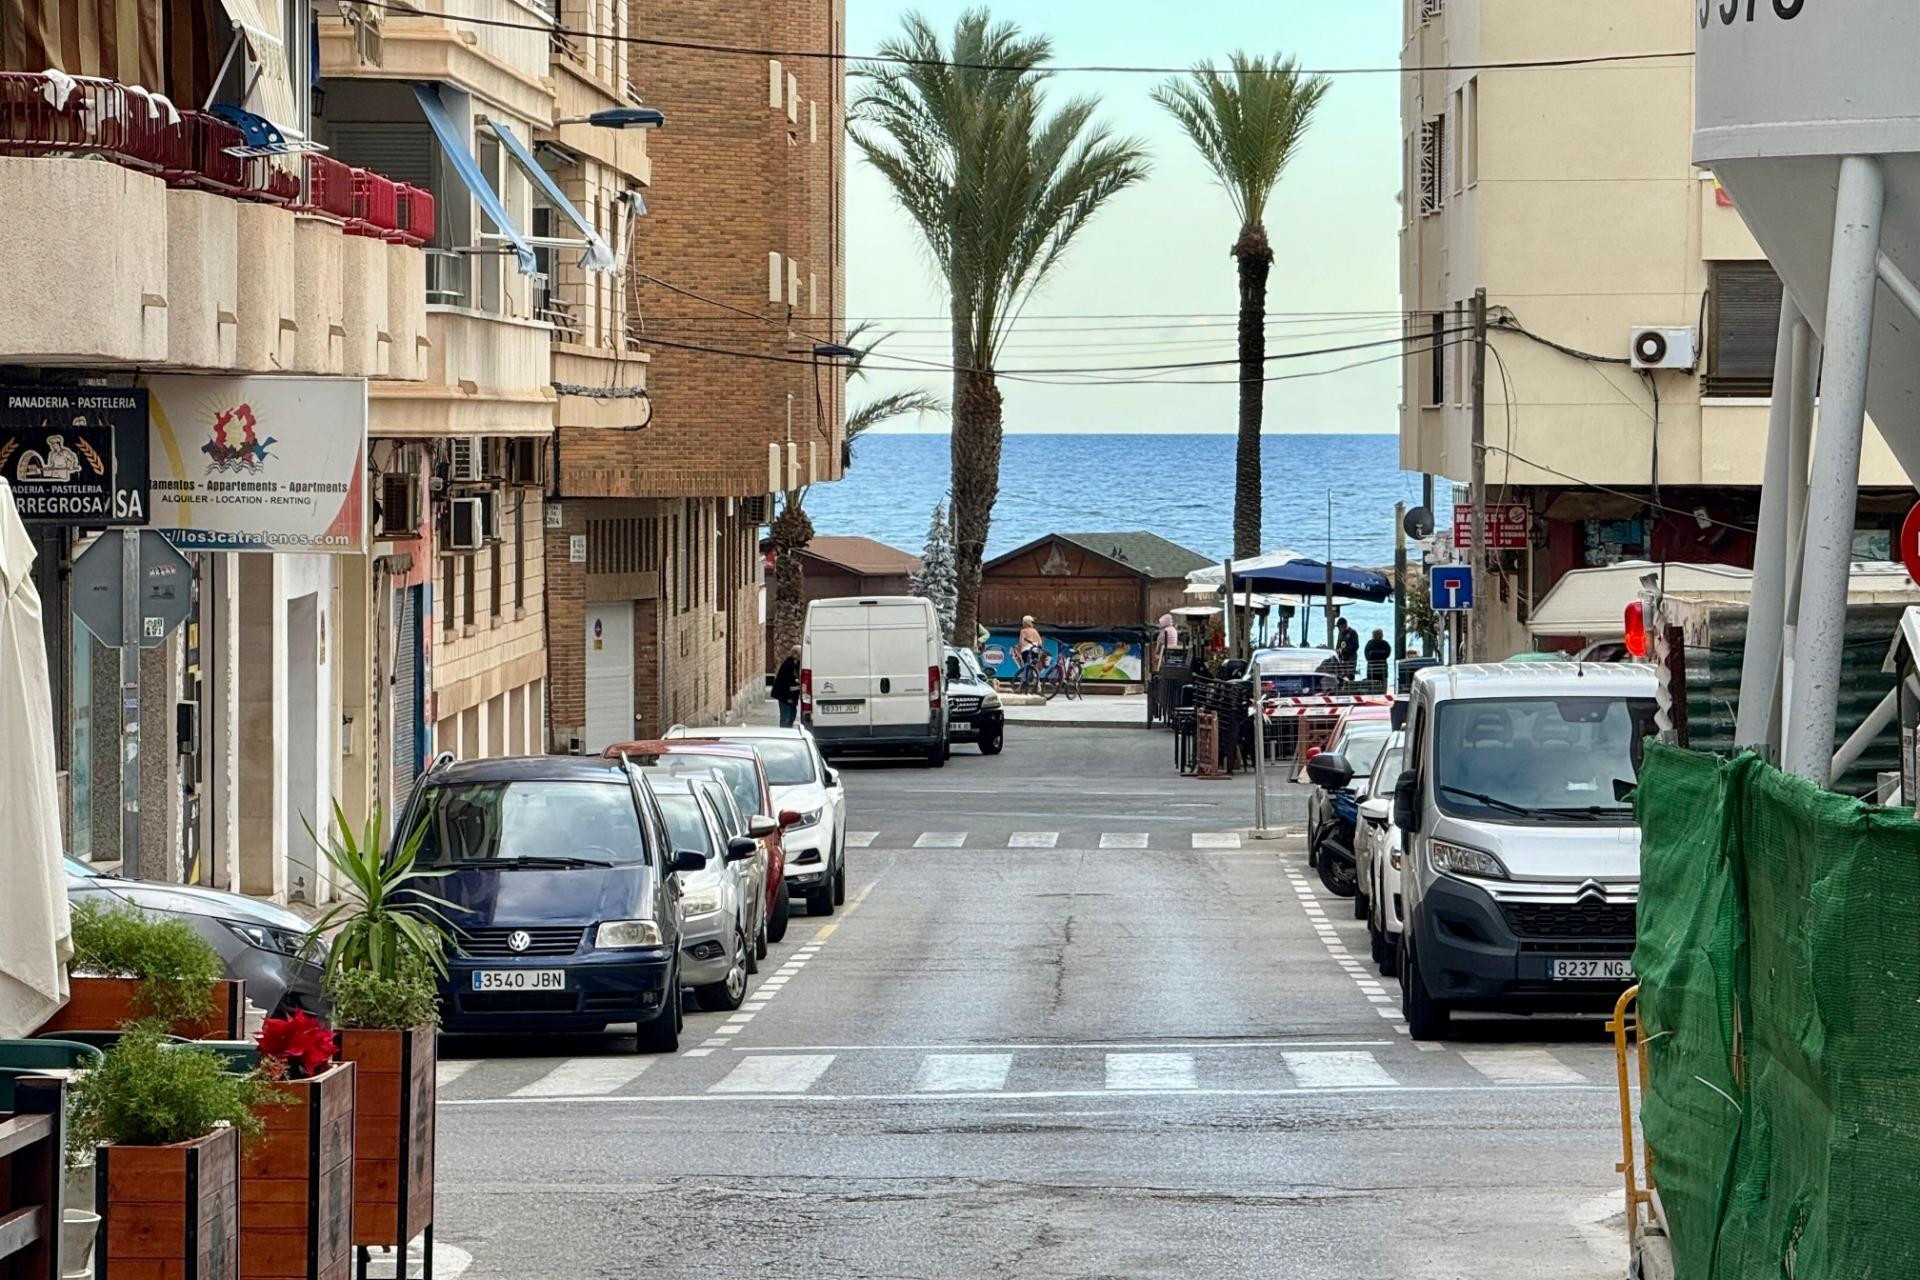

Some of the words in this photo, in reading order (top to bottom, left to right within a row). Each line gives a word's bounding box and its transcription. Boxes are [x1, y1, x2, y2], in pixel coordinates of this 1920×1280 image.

[8, 396, 70, 409] PANADERIA
[77, 397, 137, 409] PASTELERIA
[12, 485, 45, 494] ADERIA
[51, 485, 103, 494] PASTELERIA
[207, 480, 278, 493] Appartements
[289, 481, 348, 494] Apartments
[16, 497, 103, 514] RREGROSA
[161, 495, 208, 504] ALQUILER
[215, 495, 263, 505] LOCATION
[270, 496, 311, 505] RENTING
[1456, 513, 1504, 523] MAKET
[164, 529, 349, 545] ://los3catralenos.com
[1558, 961, 1598, 976] 8237
[483, 973, 525, 988] 3540
[531, 972, 562, 988] JBN
